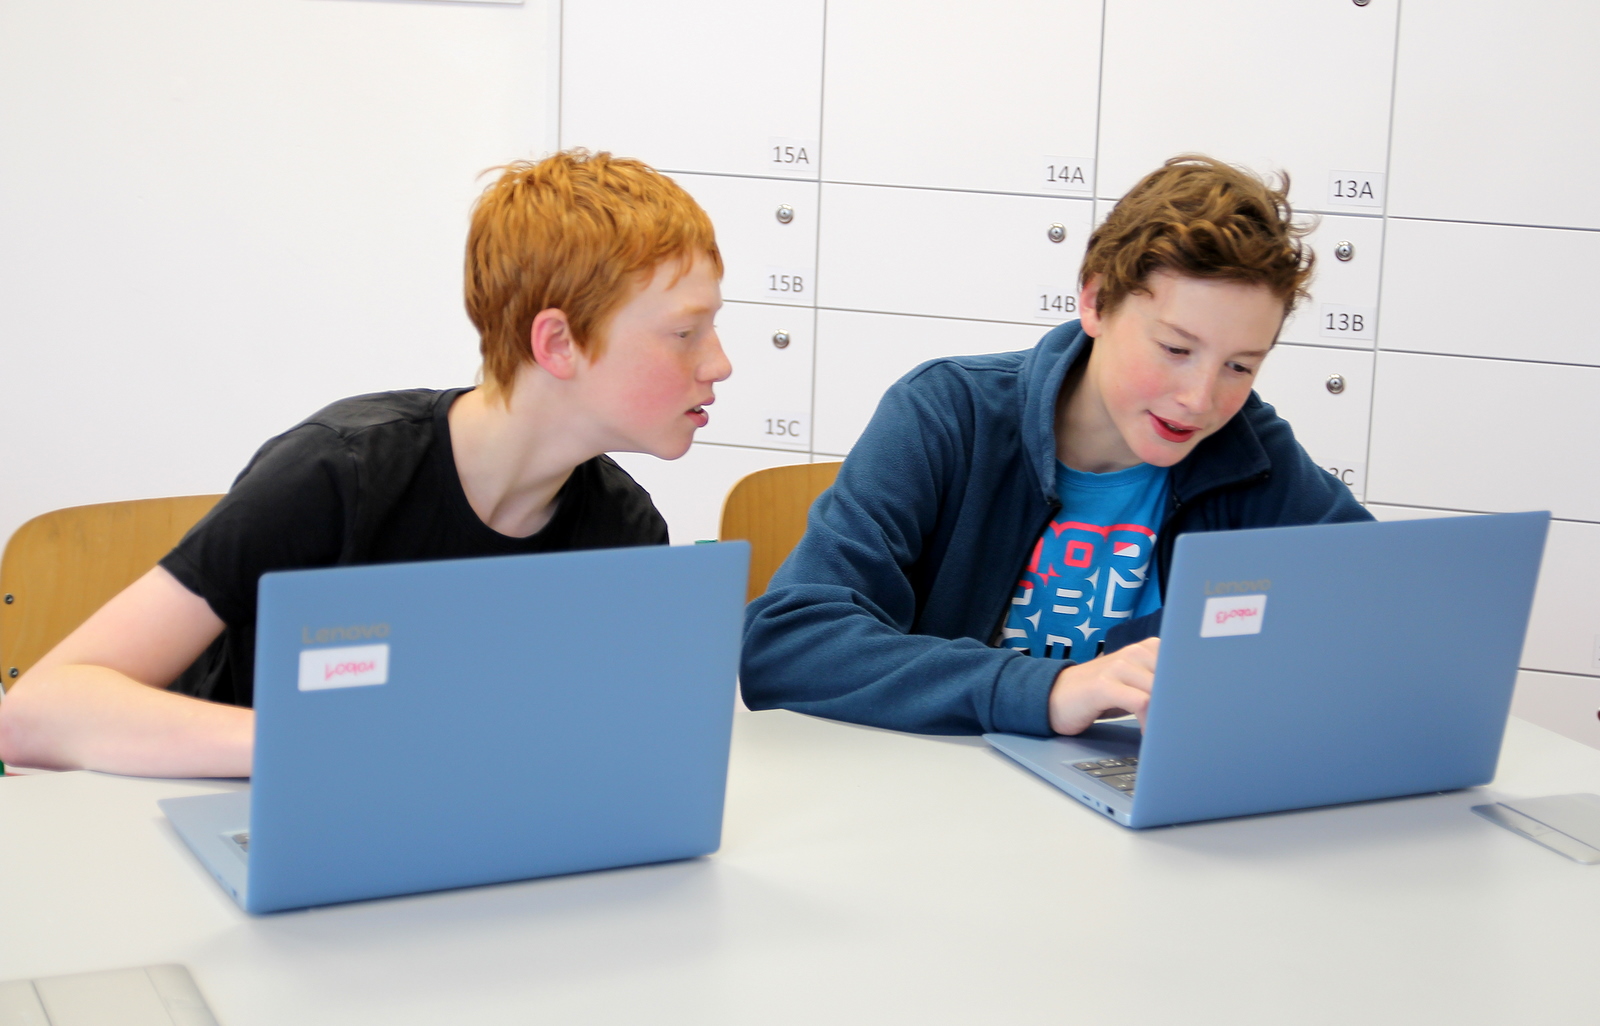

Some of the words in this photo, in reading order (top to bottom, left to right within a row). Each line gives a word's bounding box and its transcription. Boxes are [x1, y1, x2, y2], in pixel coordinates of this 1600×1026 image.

[774, 146, 809, 164] 15A
[1048, 165, 1084, 183] 14A
[1334, 180, 1373, 199] 13A
[770, 275, 803, 292] 15B
[1041, 295, 1076, 312] 14B
[1326, 313, 1363, 331] 13B
[767, 419, 798, 436] 15C
[1321, 466, 1355, 486] 3C
[1204, 579, 1272, 596] Lenovo
[302, 623, 390, 645] Lenovo
